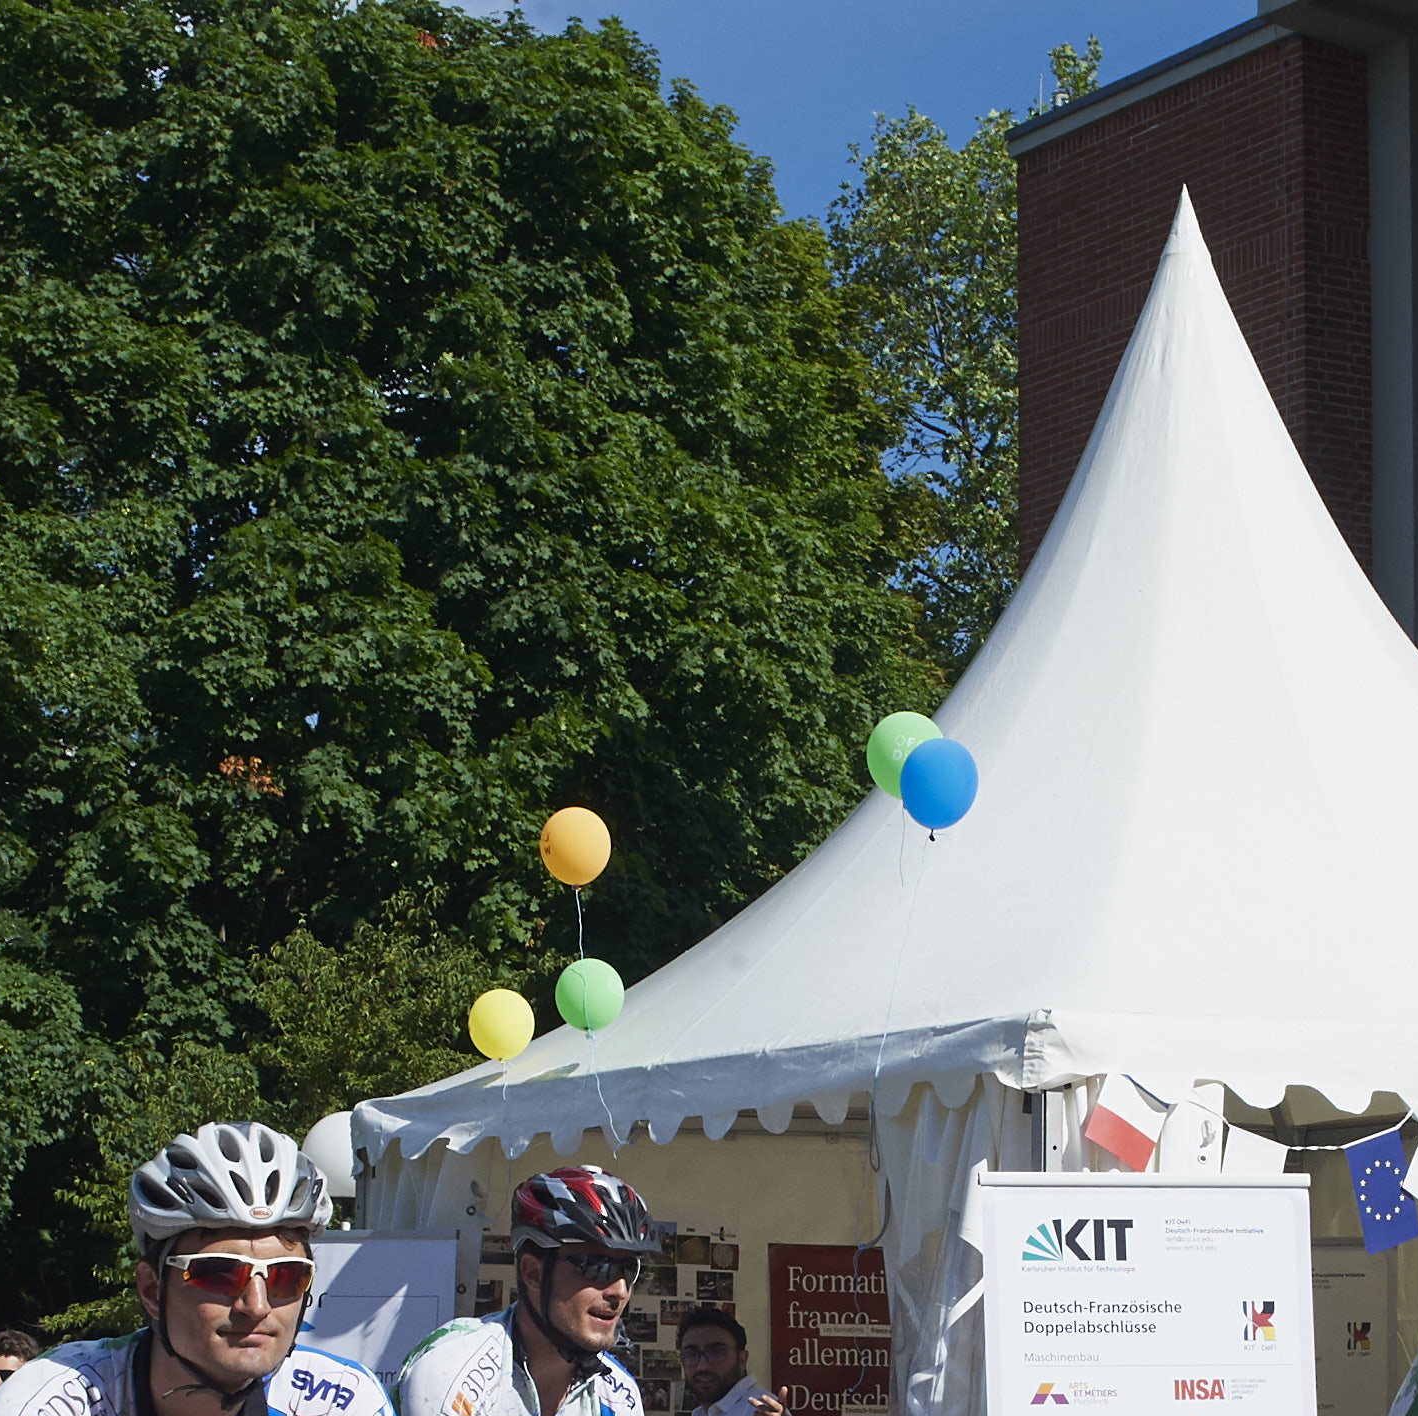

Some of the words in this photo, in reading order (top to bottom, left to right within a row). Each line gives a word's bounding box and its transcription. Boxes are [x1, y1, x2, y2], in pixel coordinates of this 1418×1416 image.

[1052, 1219, 1134, 1261] KIT
[788, 1266, 886, 1294] Formati
[788, 1301, 879, 1328] franco-
[1023, 1300, 1182, 1313] Deutsch-Französische
[1024, 1320, 1157, 1337] Doppelabschlüsse
[789, 1338, 890, 1367] alleman
[1024, 1352, 1099, 1362] Maschinenbau
[461, 1346, 502, 1404] 3DSE
[790, 1383, 889, 1412] Deutsch
[1174, 1379, 1225, 1400] INSA
